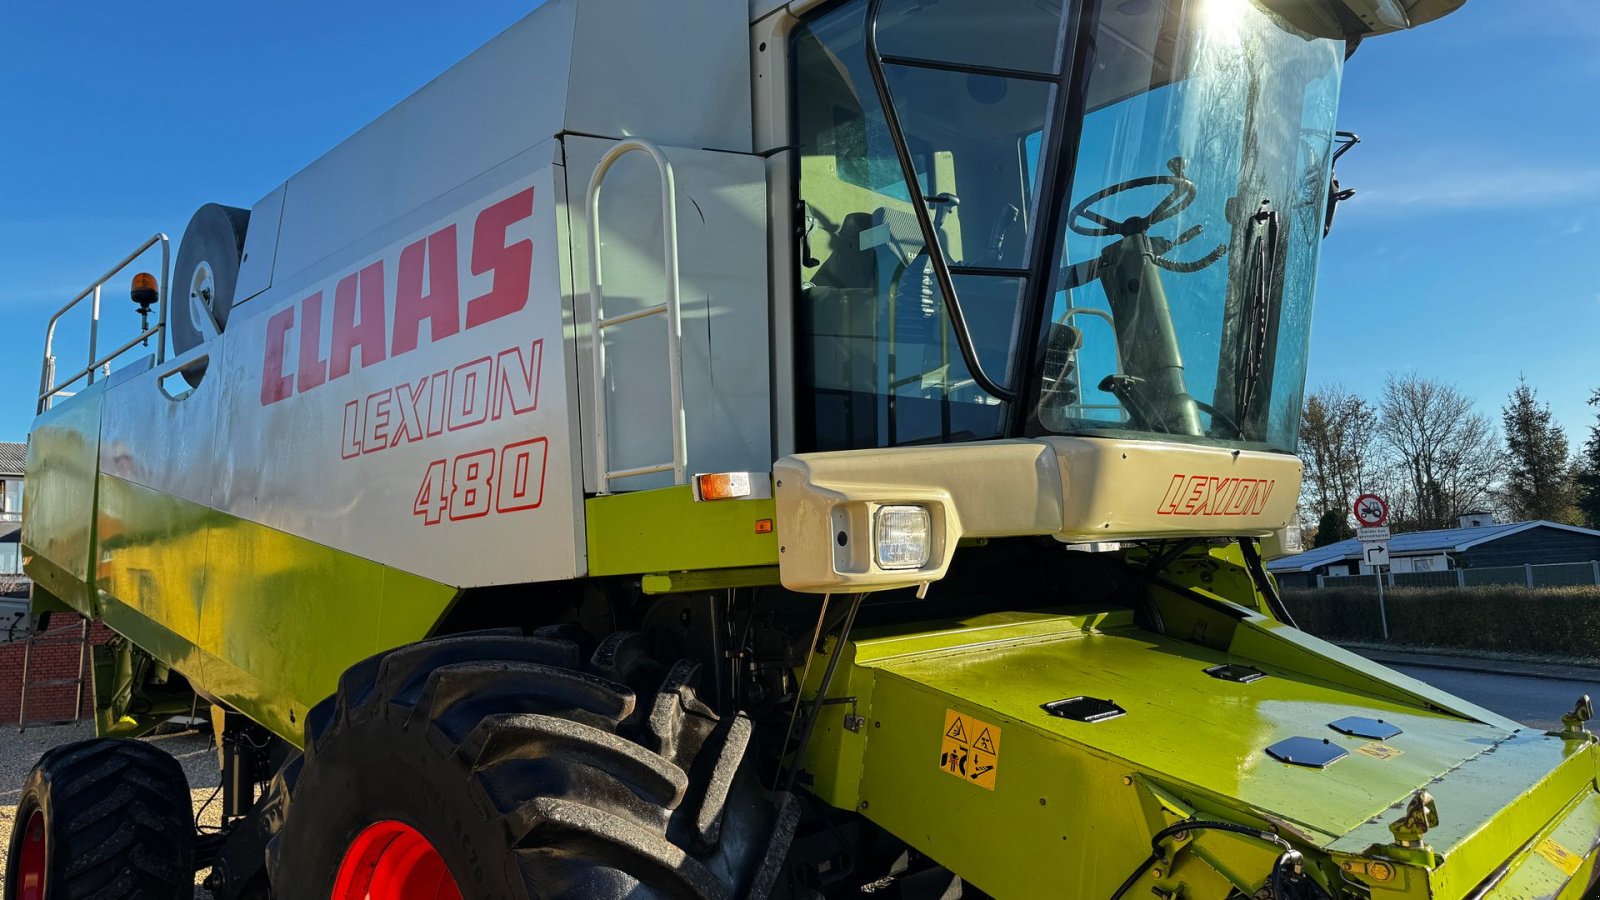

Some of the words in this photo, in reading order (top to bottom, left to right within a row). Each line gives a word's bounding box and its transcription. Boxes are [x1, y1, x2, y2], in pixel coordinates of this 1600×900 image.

[260, 185, 535, 407] CLAAS
[341, 338, 544, 460] LEXION
[413, 436, 548, 526] 480
[1157, 474, 1276, 516] LEXION
